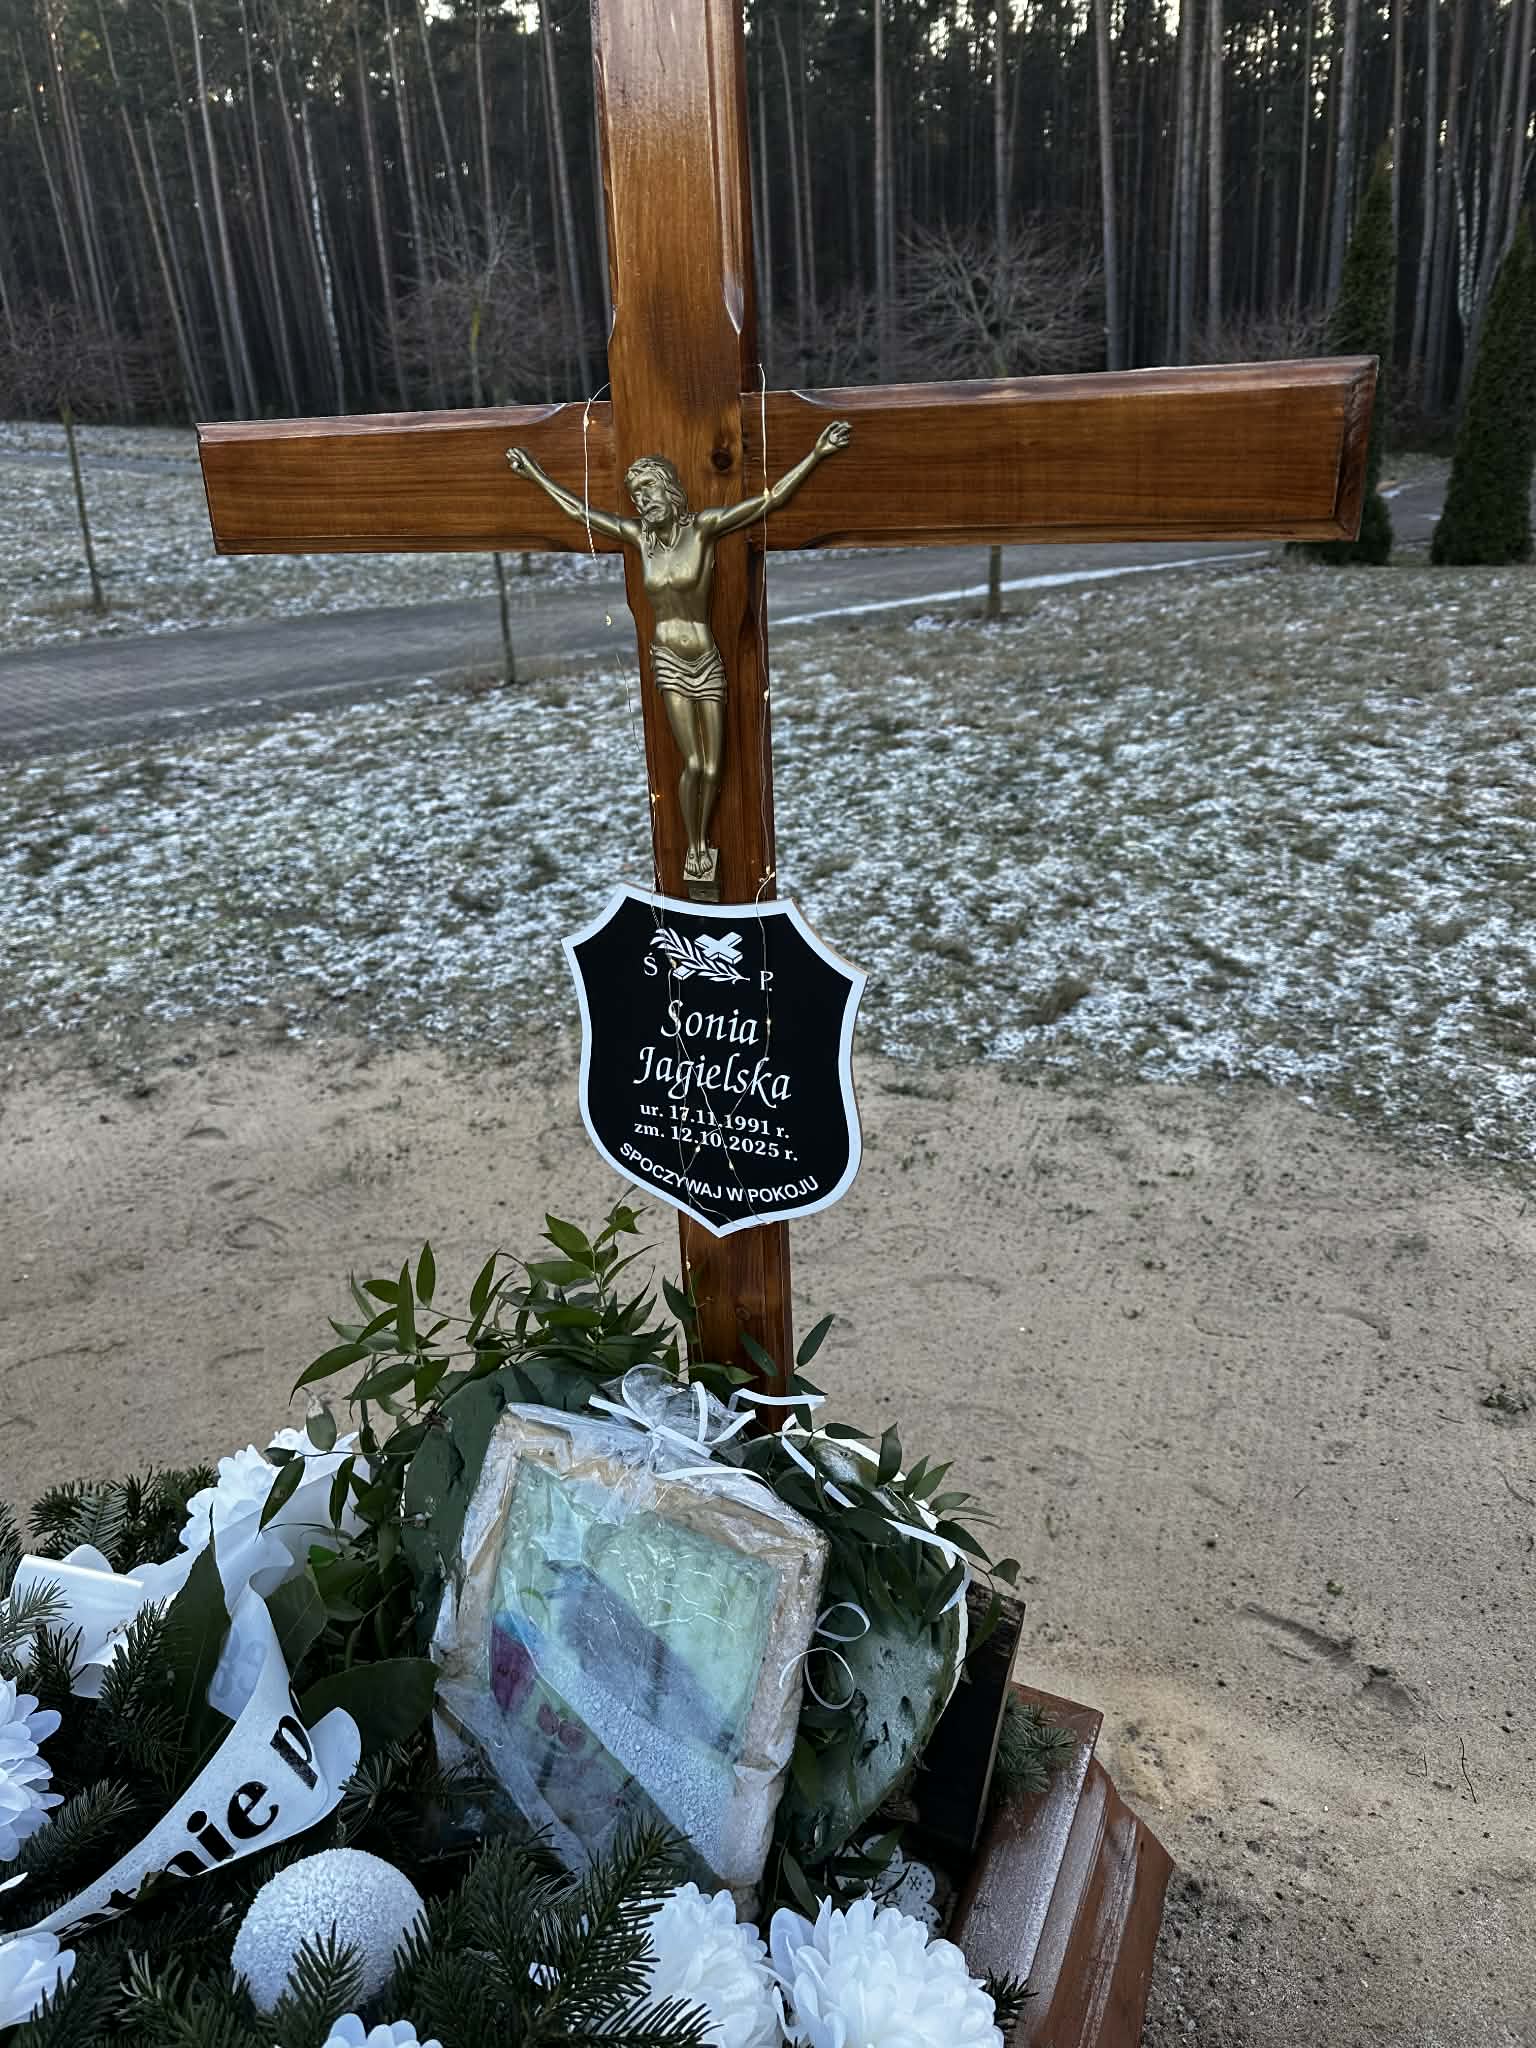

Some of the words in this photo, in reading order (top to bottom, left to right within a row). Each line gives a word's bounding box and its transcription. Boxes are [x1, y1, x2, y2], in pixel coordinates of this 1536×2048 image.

[760, 970, 774, 992] P.
[660, 999, 759, 1046] Sonia
[633, 1046, 792, 1109] Jagielska
[634, 1122, 665, 1138] zm.
[671, 1125, 779, 1158] 12.10.2025
[784, 1149, 798, 1162] r.
[640, 1103, 664, 1118] ur.
[669, 1105, 770, 1136] 17.11.1991
[776, 1126, 790, 1139] r.
[619, 1142, 722, 1199] SPOCZYWAJ
[726, 1187, 744, 1202] W
[749, 1175, 819, 1203] POKOJU
